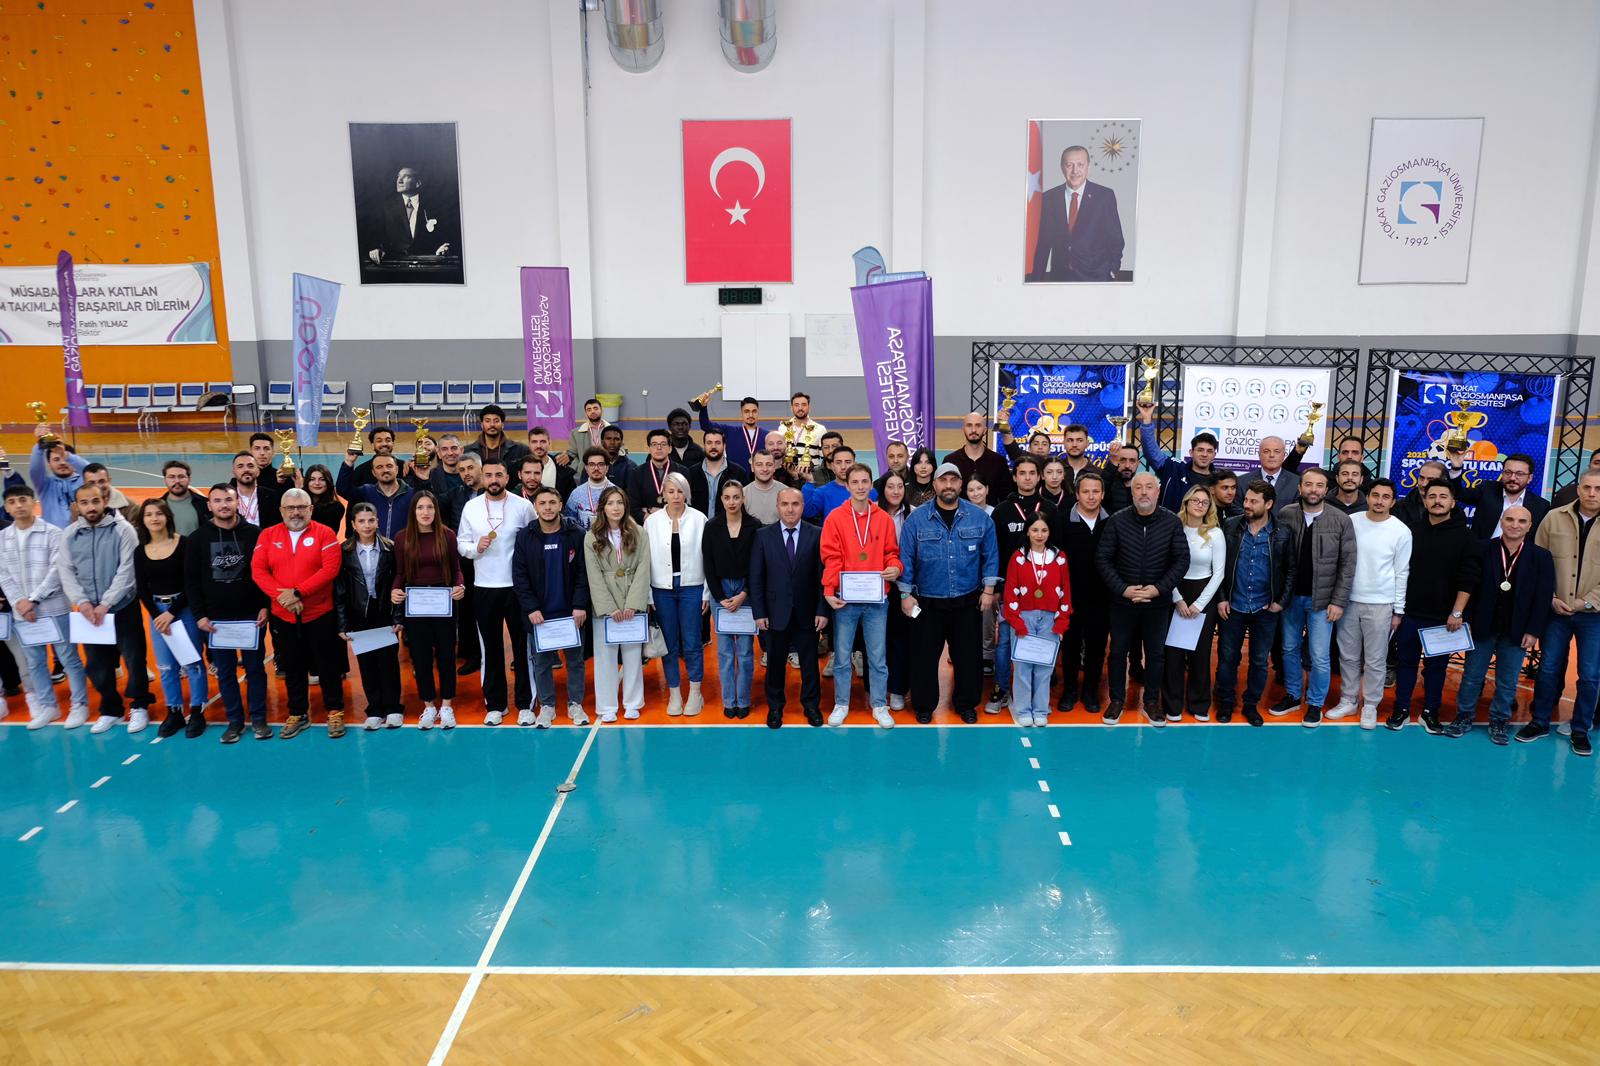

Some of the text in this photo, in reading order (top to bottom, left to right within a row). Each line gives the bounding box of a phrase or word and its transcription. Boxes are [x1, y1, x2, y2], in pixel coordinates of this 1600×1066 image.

[1376, 157, 1452, 203] GAZİOSMANPAŞA
[1376, 206, 1395, 239] TOKAT
[1404, 236, 1429, 247] 1992
[10, 286, 158, 298] MÜSABALARA KATILAN
[78, 301, 142, 314] BAŞARILAR
[146, 298, 190, 311] DİLERİM
[1450, 392, 1523, 402] GAZİOSMANPAŞA
[1226, 428, 1258, 437] TOKAT
